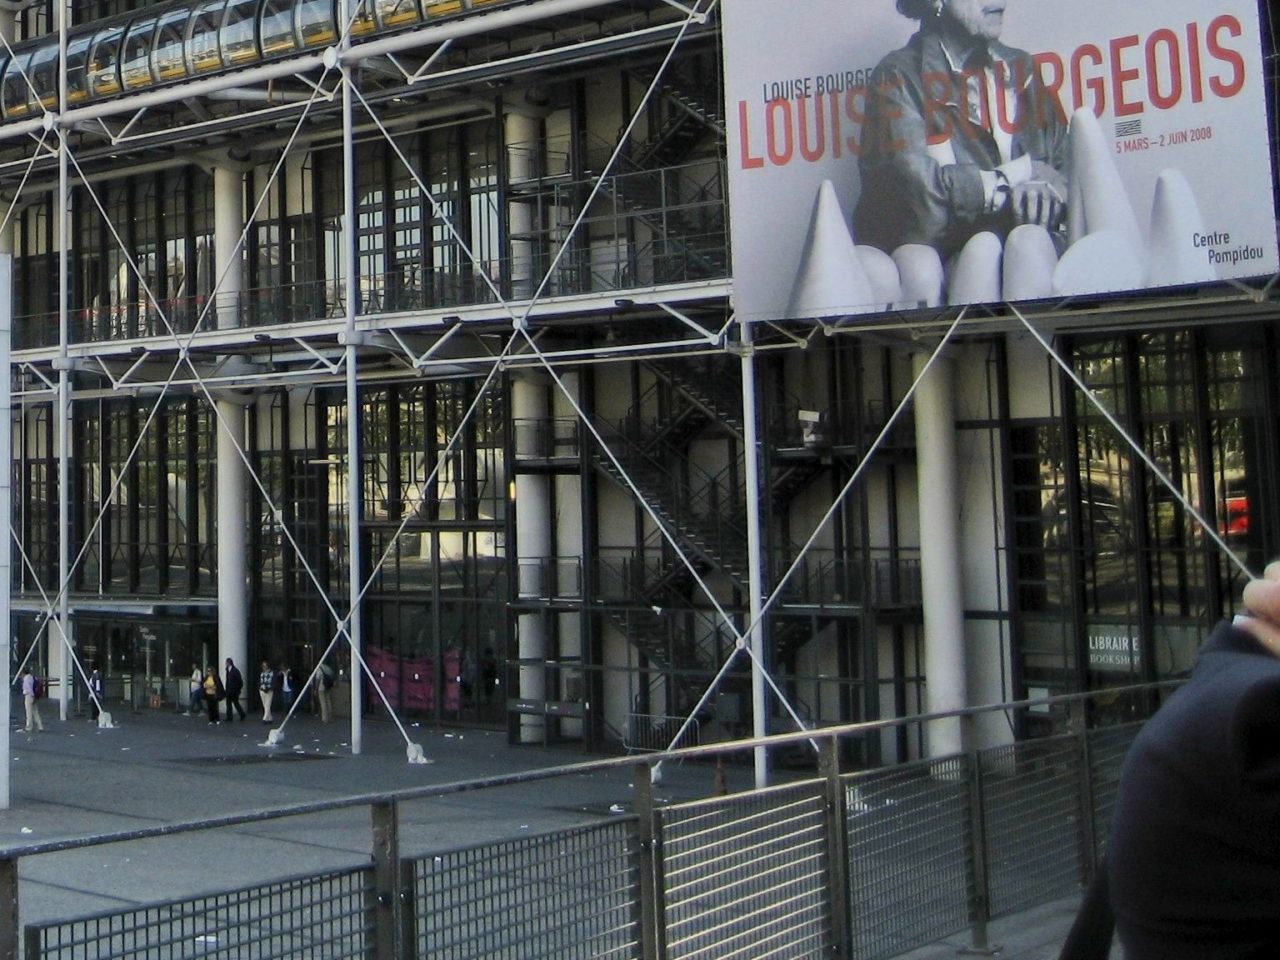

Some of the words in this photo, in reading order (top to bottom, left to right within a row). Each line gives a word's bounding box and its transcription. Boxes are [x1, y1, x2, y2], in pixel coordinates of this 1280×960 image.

[739, 75, 906, 170] LOUISE
[922, 14, 1246, 145] BOURGEOIS
[764, 77, 812, 103] LOUISE
[1116, 141, 1122, 154] 5
[1124, 137, 1150, 152] MARS
[1159, 134, 1165, 147] 2
[1167, 130, 1188, 146] JUIN
[1190, 126, 1212, 142] 2008
[1193, 231, 1230, 248] Centre
[1208, 245, 1264, 266] Pompidou
[1089, 636, 1139, 651] LIBRAIRE
